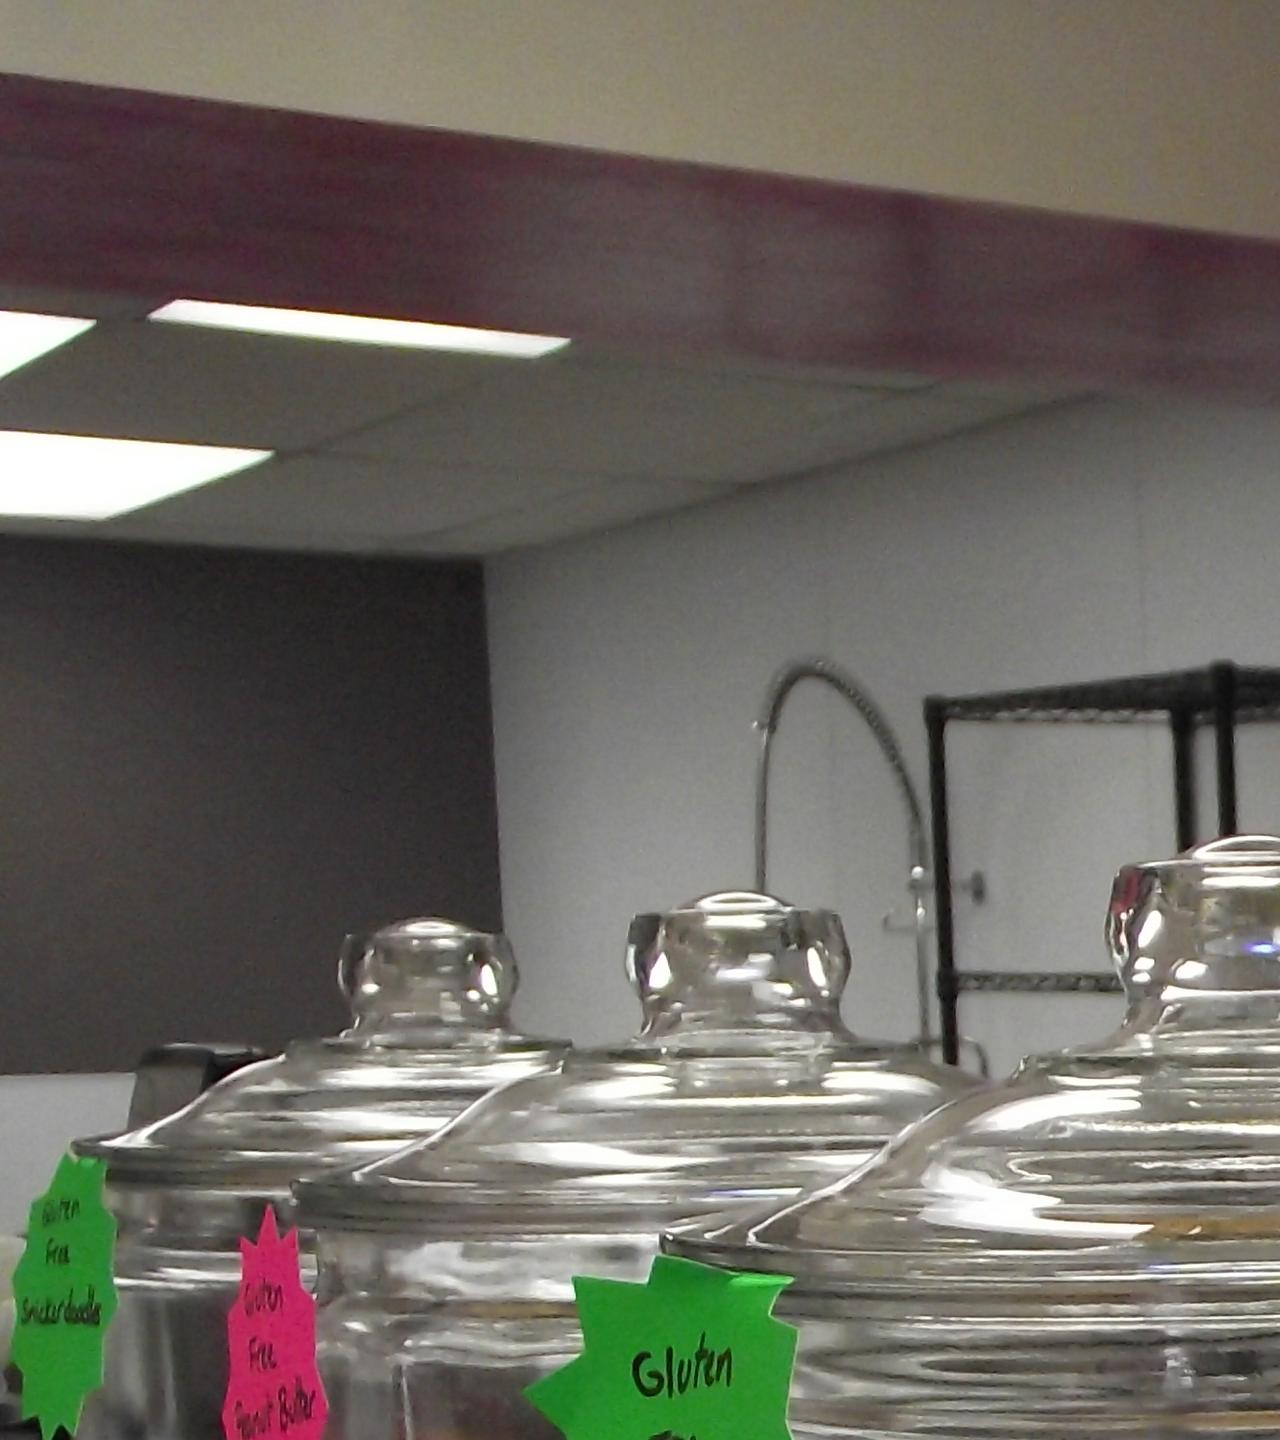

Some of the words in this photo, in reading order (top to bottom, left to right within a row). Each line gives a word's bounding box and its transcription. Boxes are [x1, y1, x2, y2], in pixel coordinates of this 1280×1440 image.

[45, 1237, 71, 1265] Free
[244, 1278, 283, 1316] Gluten
[249, 1337, 277, 1372] Free
[631, 1331, 732, 1399] Gluten
[277, 1375, 316, 1434] Butter
